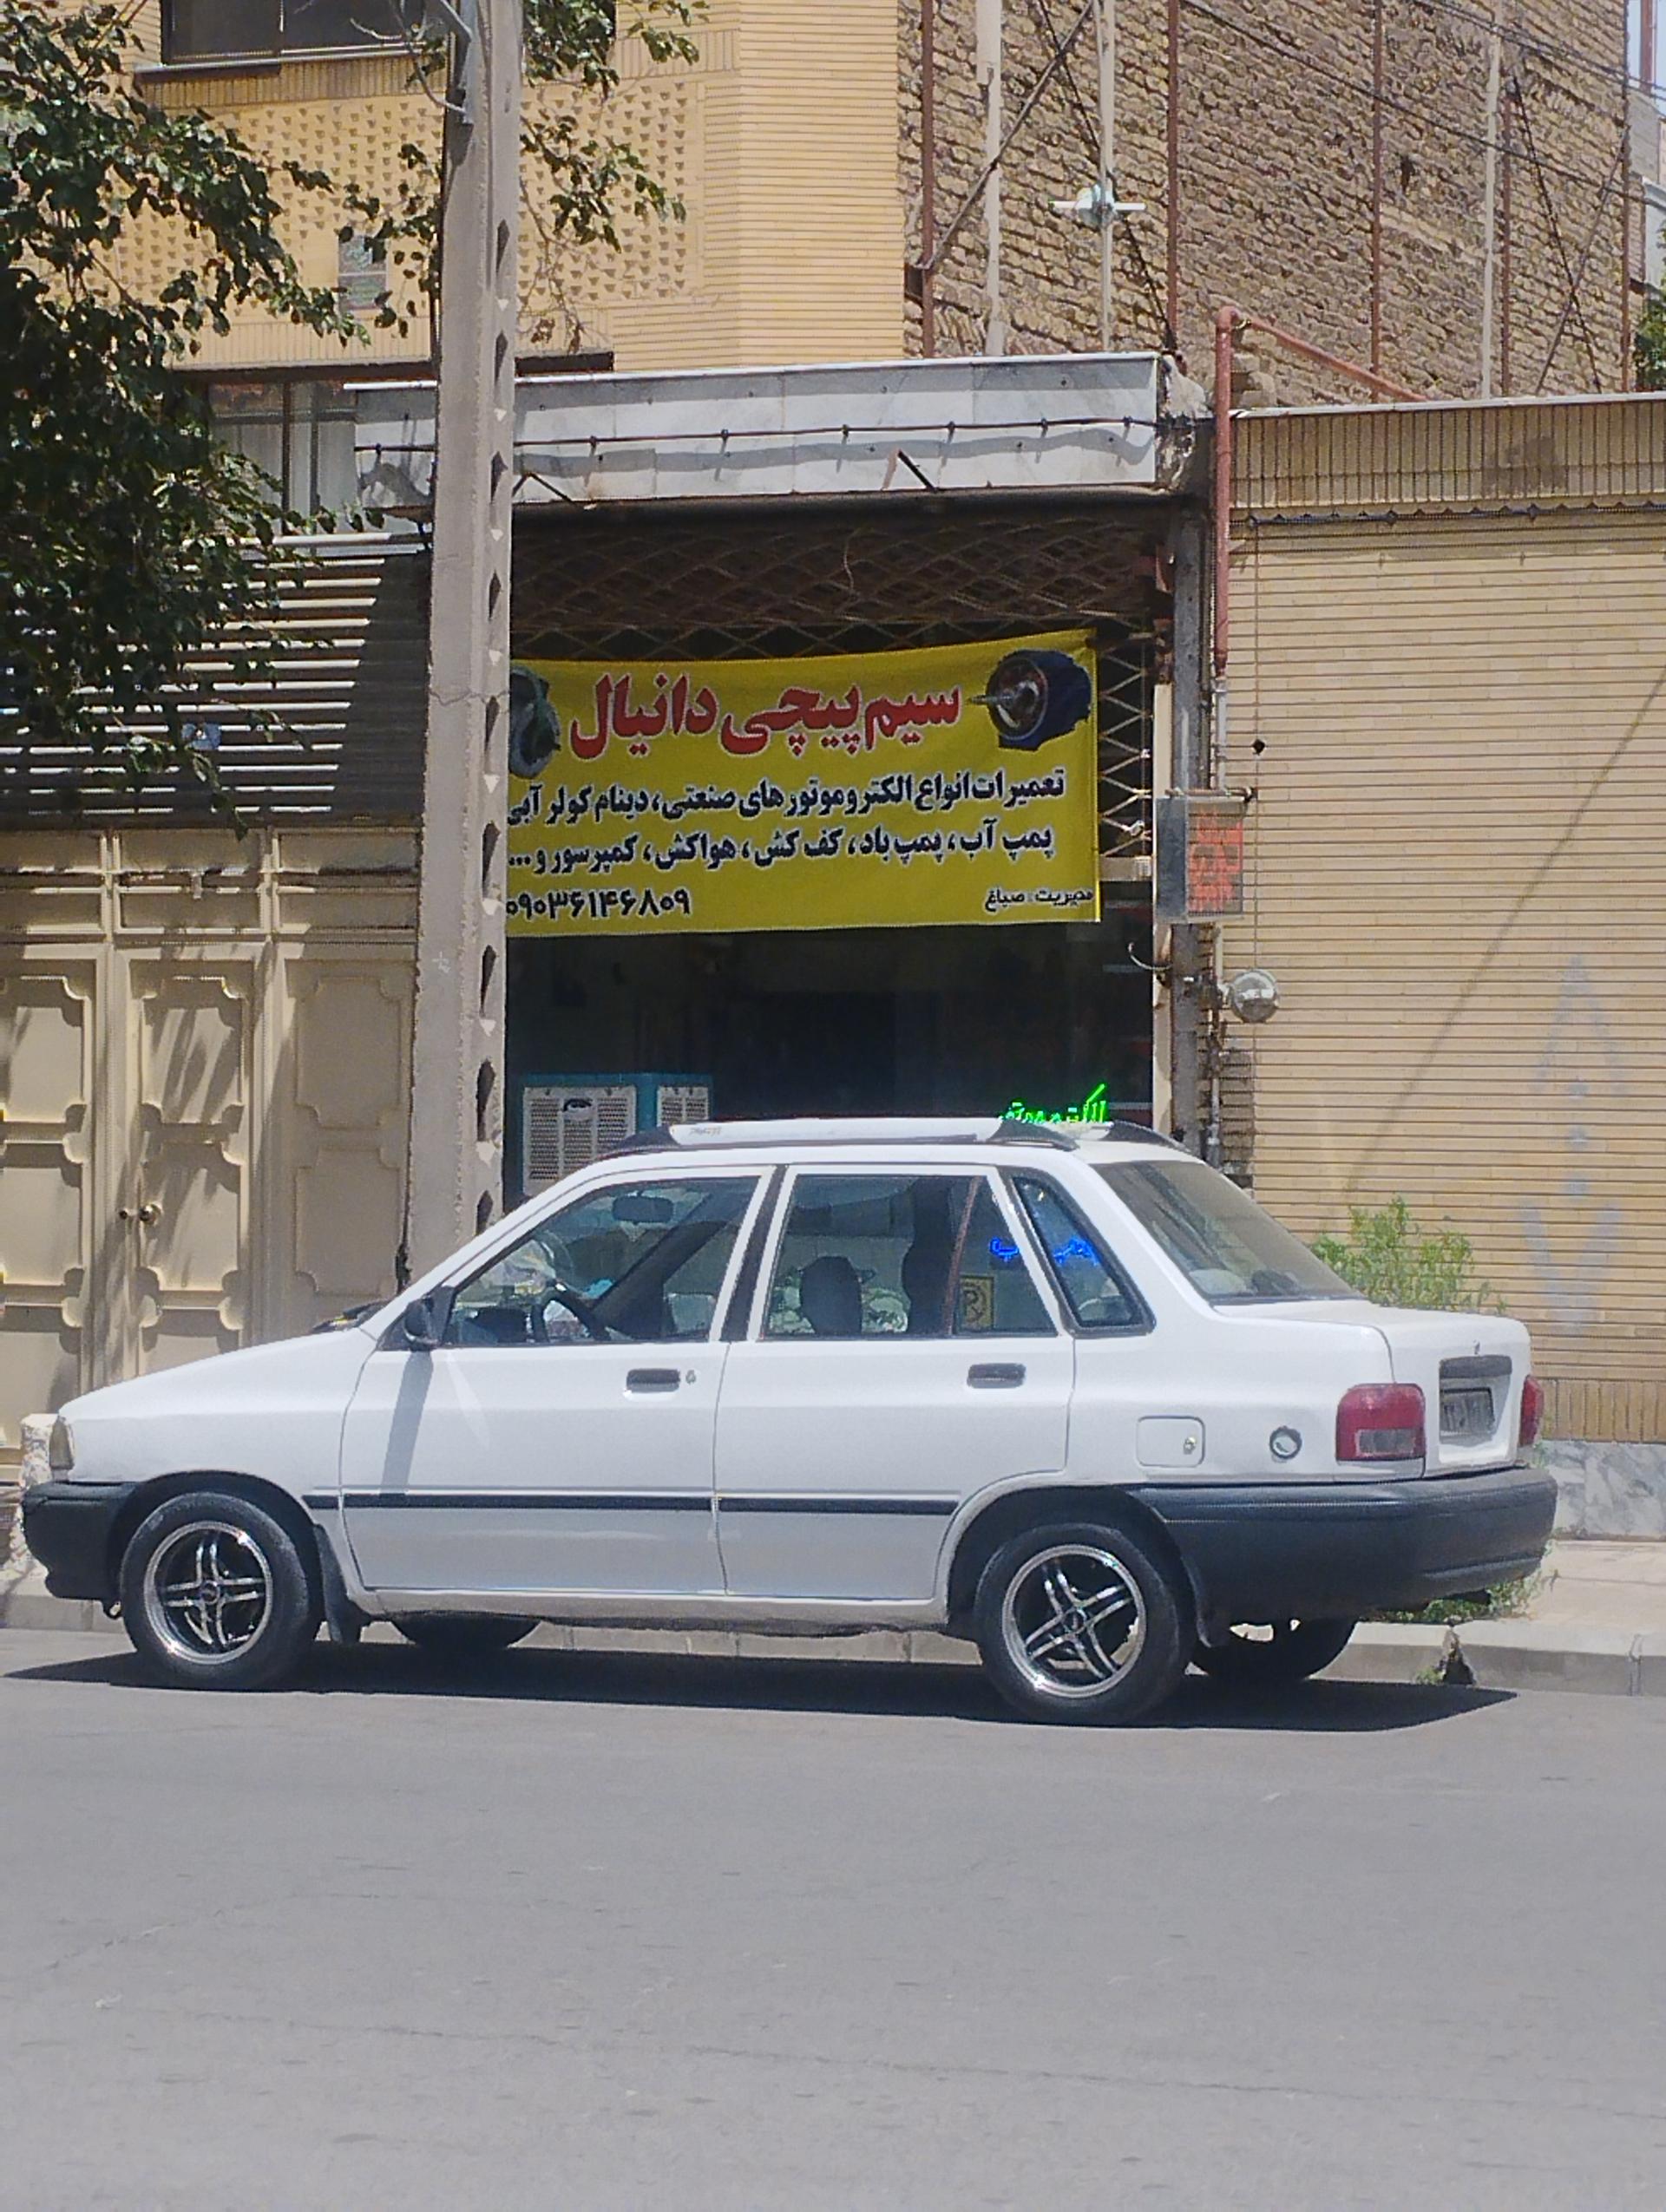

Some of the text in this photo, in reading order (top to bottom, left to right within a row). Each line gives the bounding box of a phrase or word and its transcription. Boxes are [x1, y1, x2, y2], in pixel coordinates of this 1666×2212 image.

[569, 671, 961, 760] سیم پیچی دانیال
[506, 782, 543, 827] آبی
[545, 785, 594, 826] کولر
[594, 784, 649, 823] دینام
[914, 771, 970, 812] انواع
[971, 767, 1066, 808] تعمیرات
[550, 834, 640, 874] کمپرسور
[894, 830, 941, 864] پمپ
[1002, 827, 1053, 860] پمپ
[506, 887, 691, 920] ۰۹۰۳۶۱۴۶۸۰۹
[984, 887, 1025, 913] صباغ
